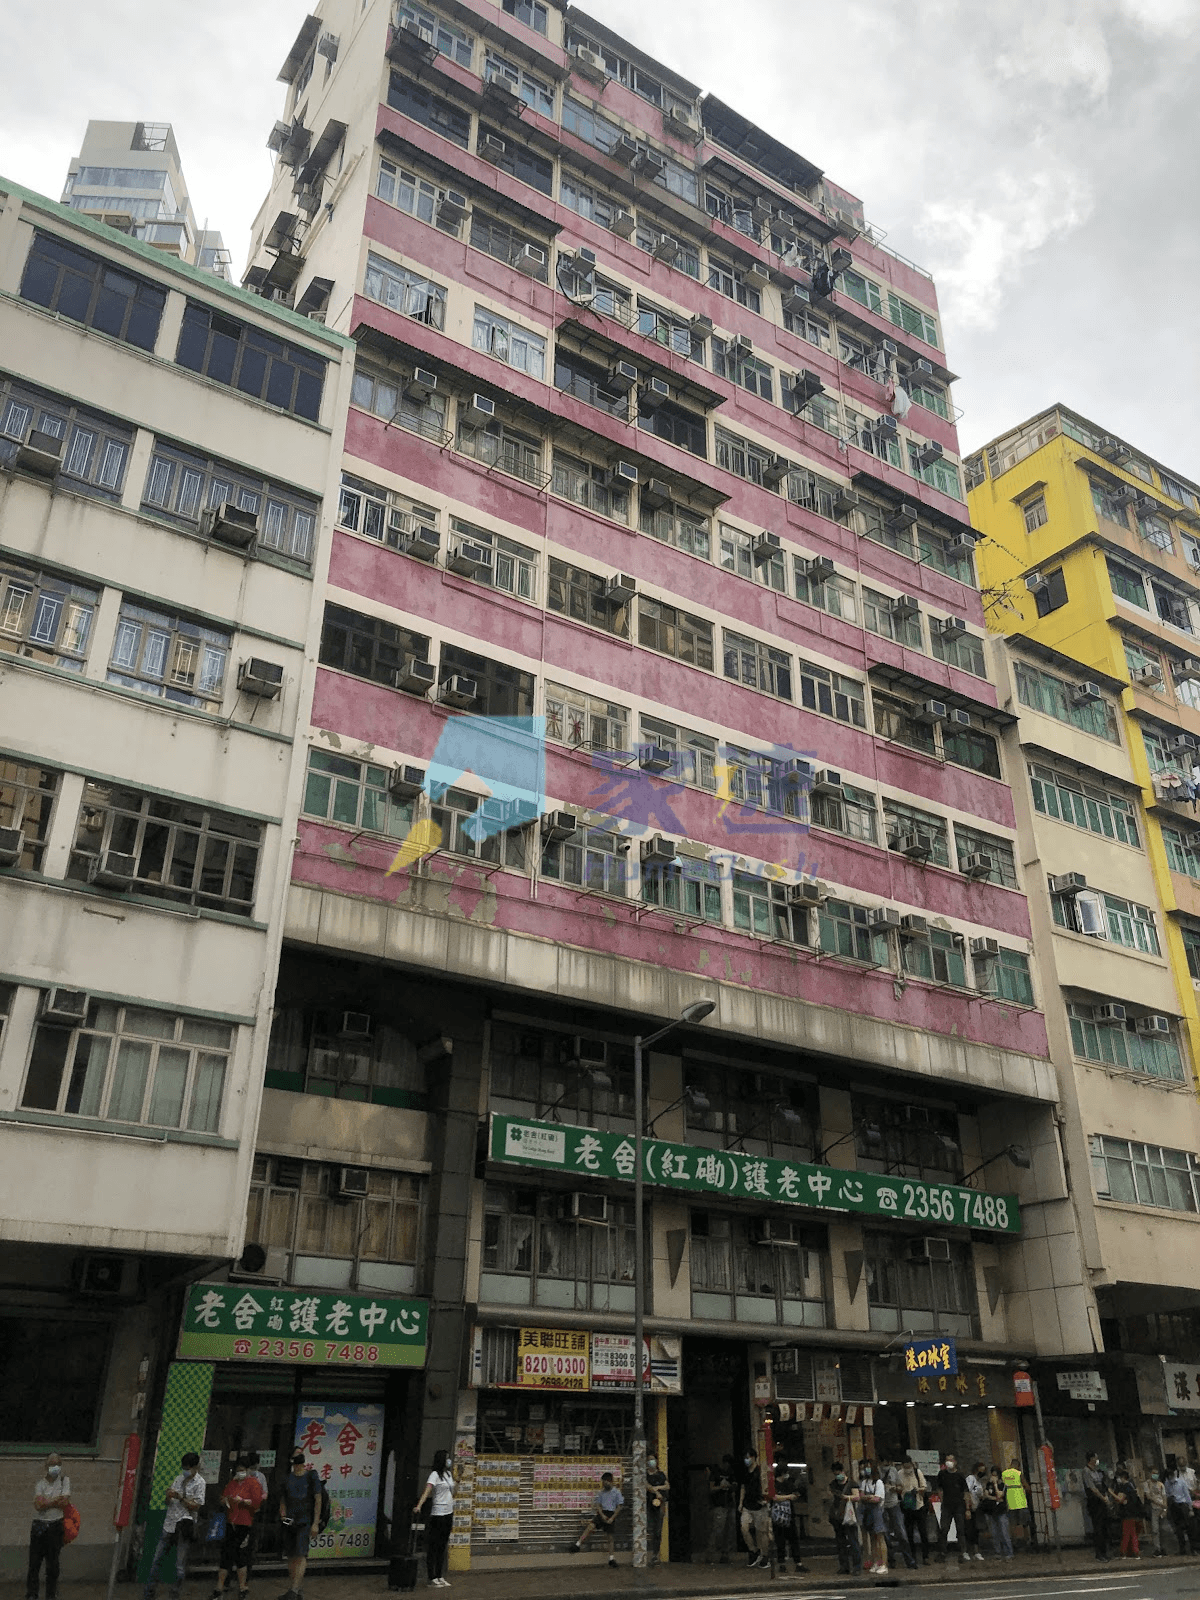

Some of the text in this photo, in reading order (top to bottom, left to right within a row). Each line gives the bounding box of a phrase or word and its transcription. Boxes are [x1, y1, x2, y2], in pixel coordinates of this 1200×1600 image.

[902, 1183, 955, 1223] 2356
[959, 1190, 1009, 1230] 7488
[257, 1339, 380, 1362] 2356 7488
[525, 1355, 586, 1375] 820-0300
[300, 1420, 364, 1456] 老舍
[310, 1533, 370, 1548] 356 7488
